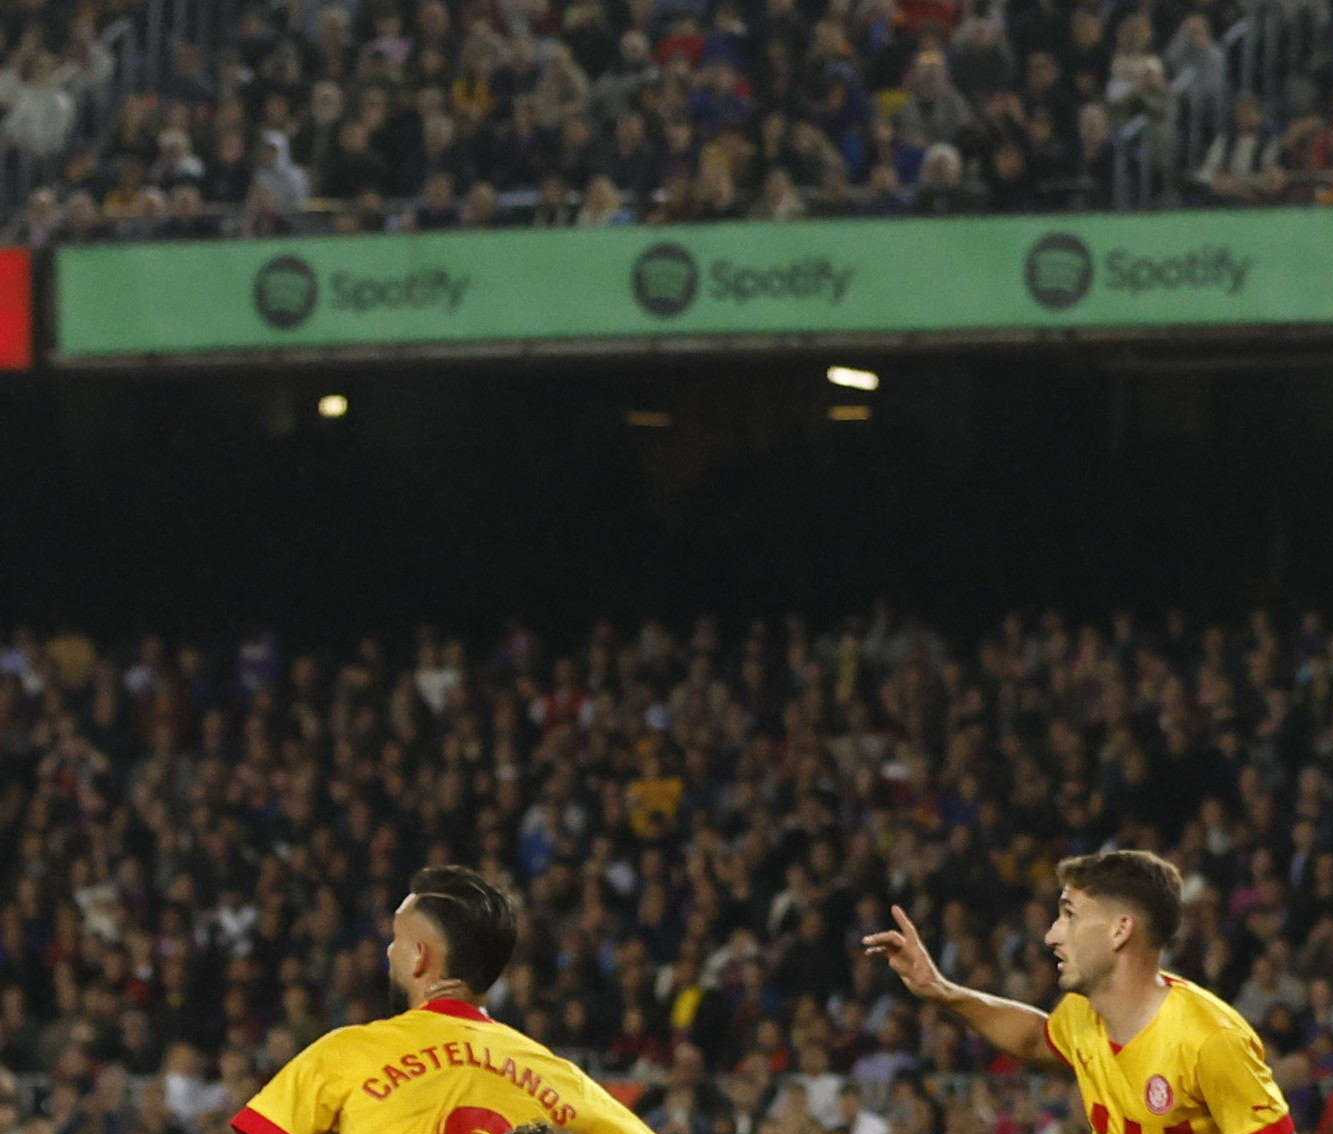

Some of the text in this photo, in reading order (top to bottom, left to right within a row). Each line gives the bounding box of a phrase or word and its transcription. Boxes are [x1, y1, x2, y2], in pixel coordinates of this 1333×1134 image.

[331, 267, 470, 313] Spotify
[710, 258, 854, 302] Spotify
[1105, 248, 1254, 294] Spotify
[363, 1041, 577, 1127] CASTELLANOS
